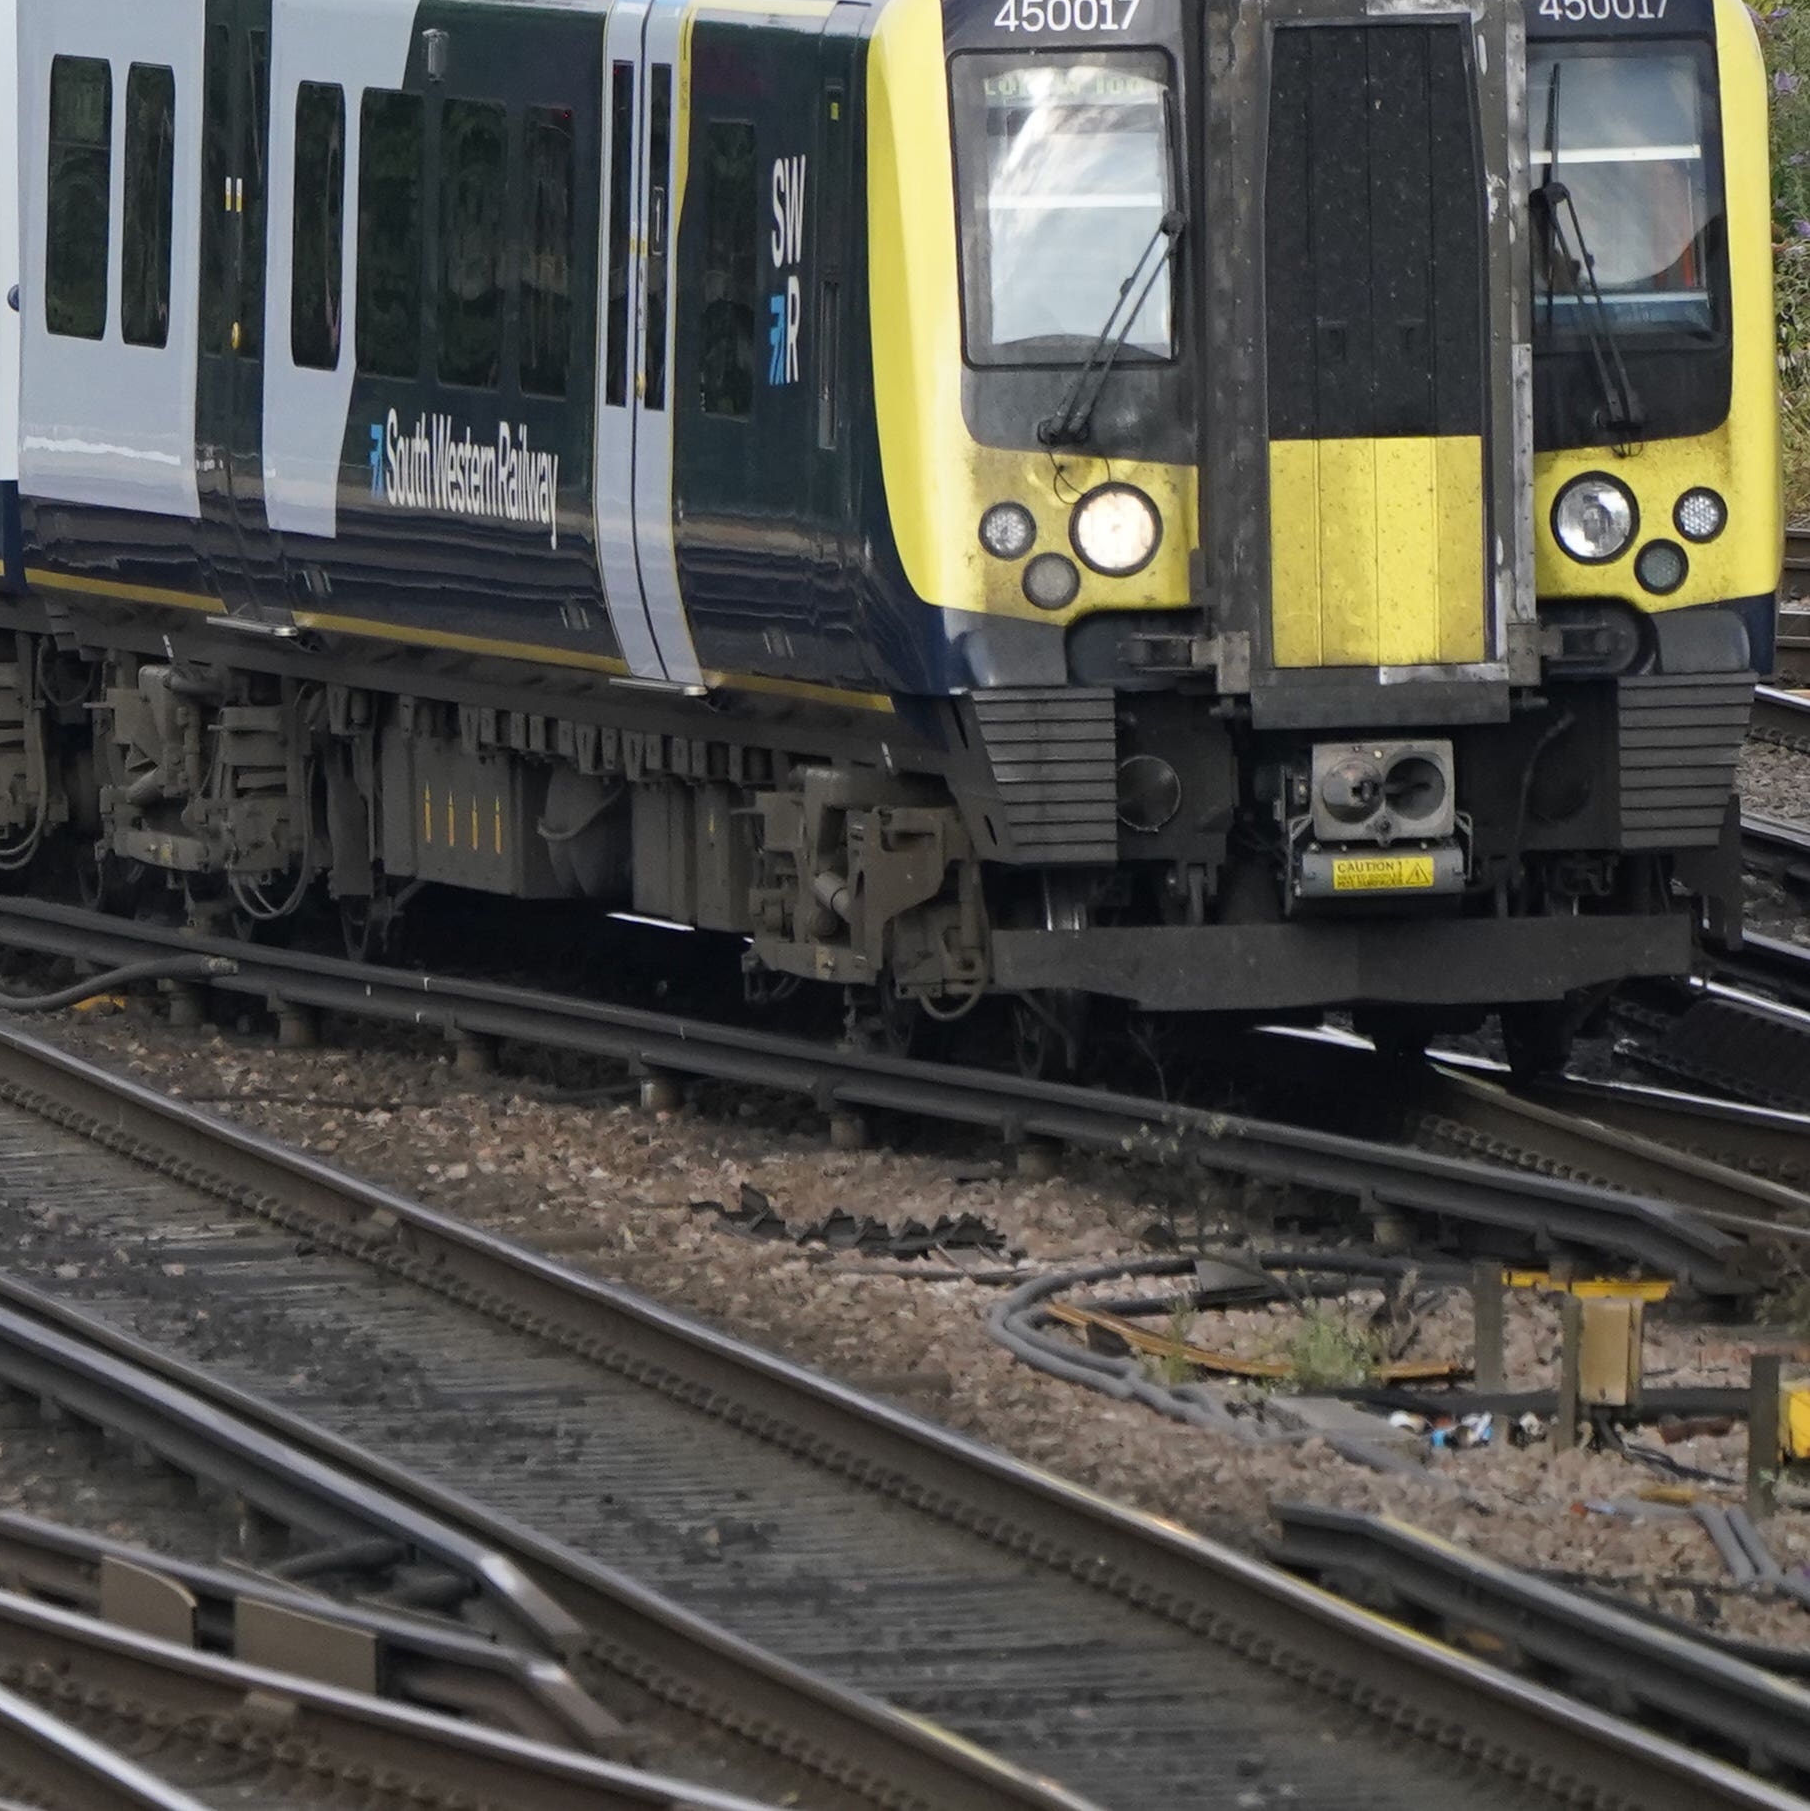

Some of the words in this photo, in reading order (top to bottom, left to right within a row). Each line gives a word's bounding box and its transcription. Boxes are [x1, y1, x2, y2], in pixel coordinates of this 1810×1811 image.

[772, 154, 806, 268] SW
[786, 275, 800, 383] R
[386, 407, 431, 509] South
[432, 412, 497, 517] Western
[498, 420, 559, 551] Railway
[1338, 861, 1394, 873] CAUTION
